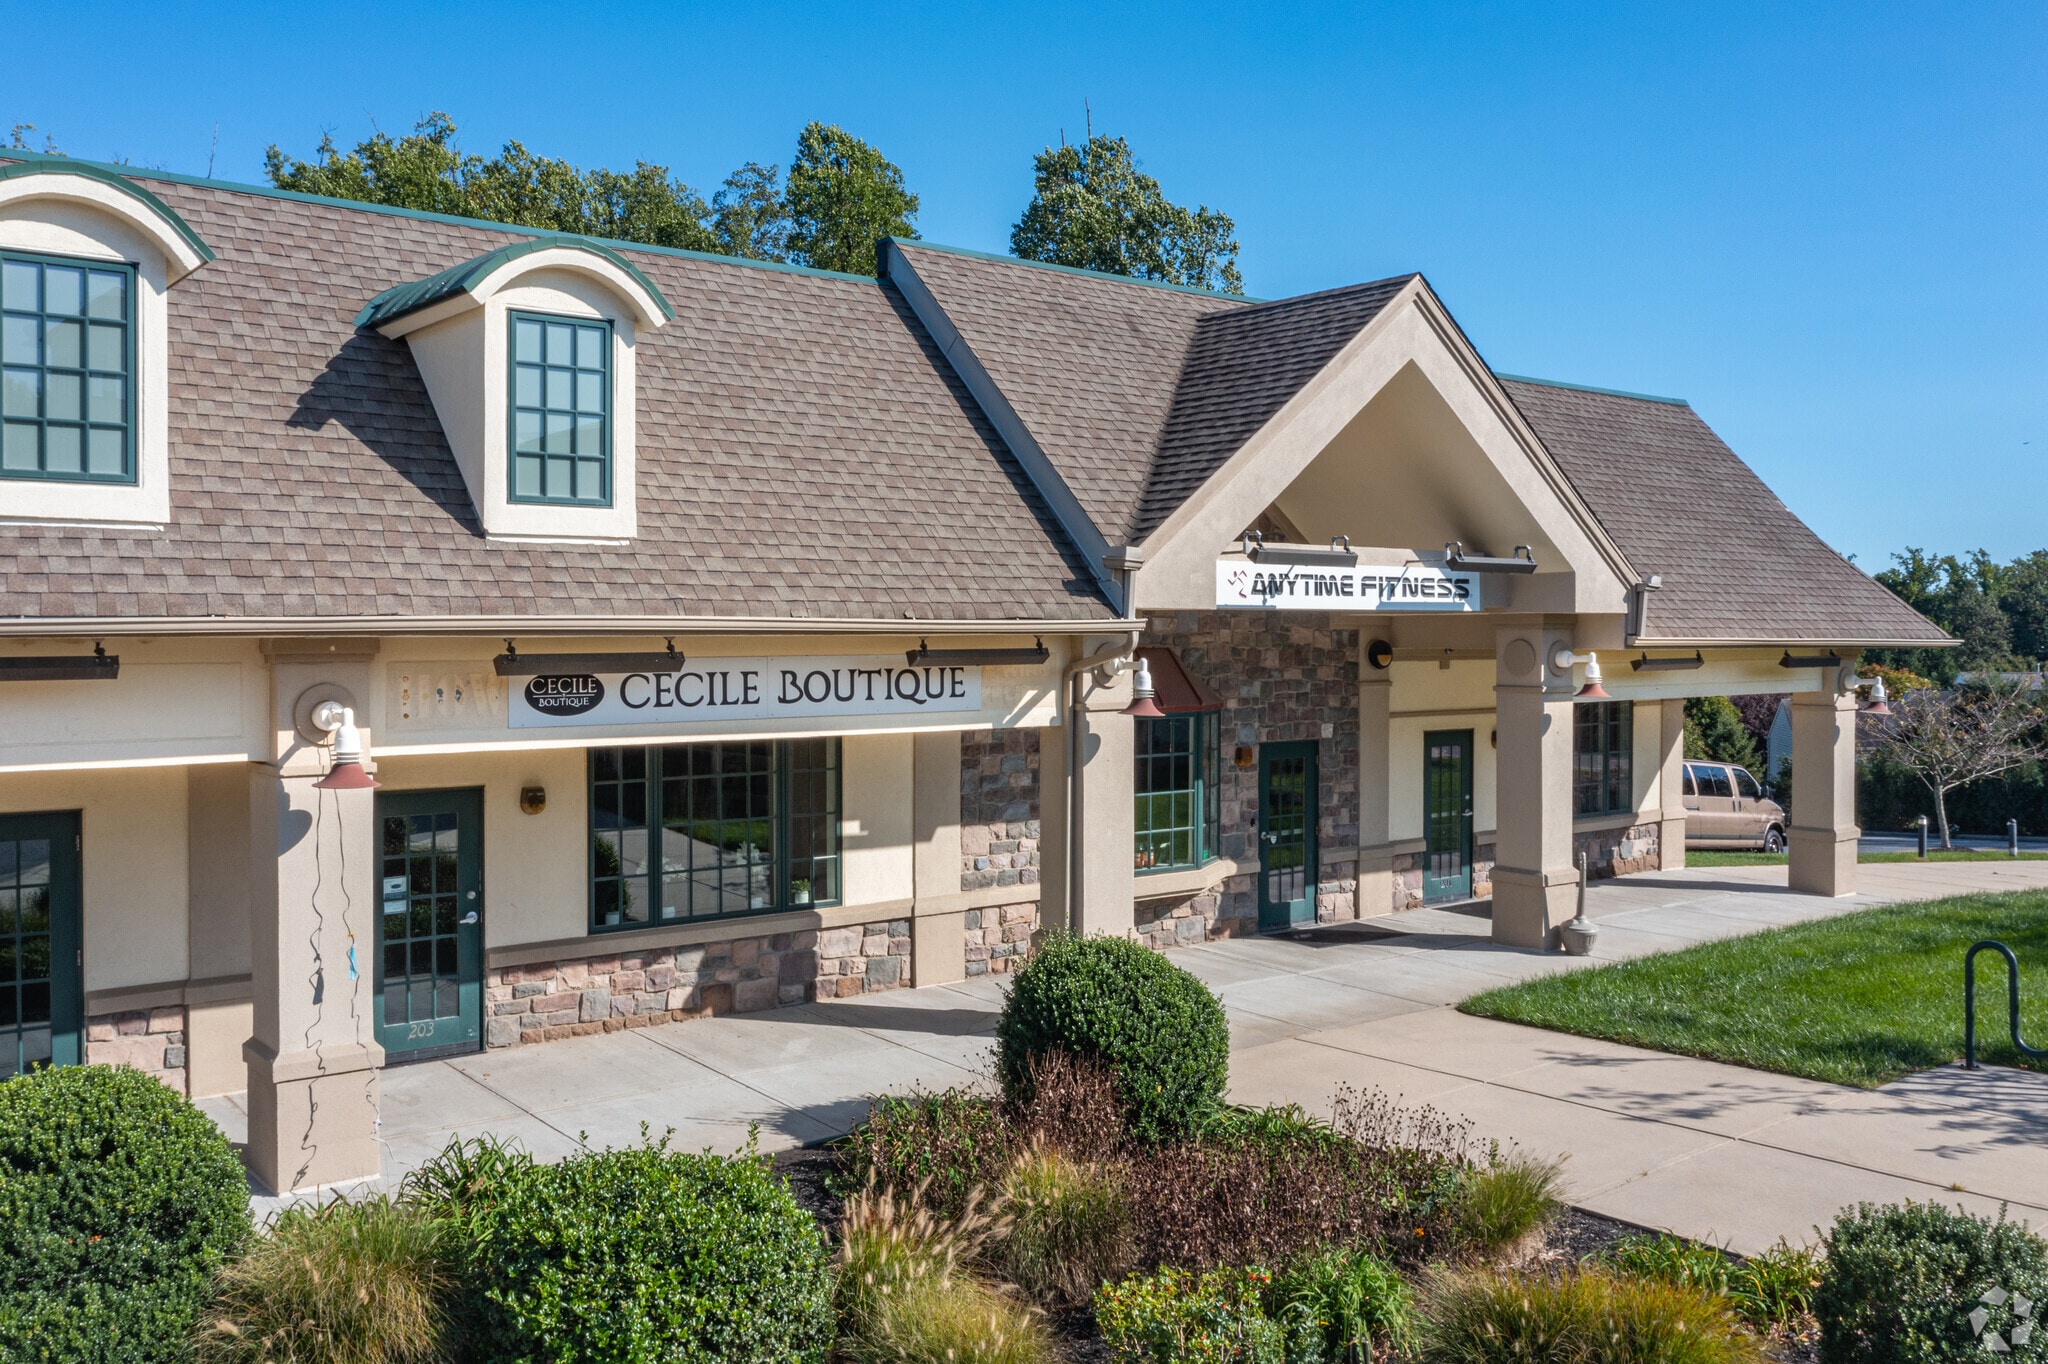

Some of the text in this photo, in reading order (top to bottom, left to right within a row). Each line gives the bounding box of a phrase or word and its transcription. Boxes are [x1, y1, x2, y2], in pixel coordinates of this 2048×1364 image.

[1251, 572, 1471, 599] ANYTIME FITNESS
[530, 677, 598, 694] CECILE
[619, 671, 761, 710] CECILE
[777, 667, 966, 705] BOUTIQUE
[538, 697, 590, 708] BOUTIQUE
[407, 1021, 435, 1040] 203
